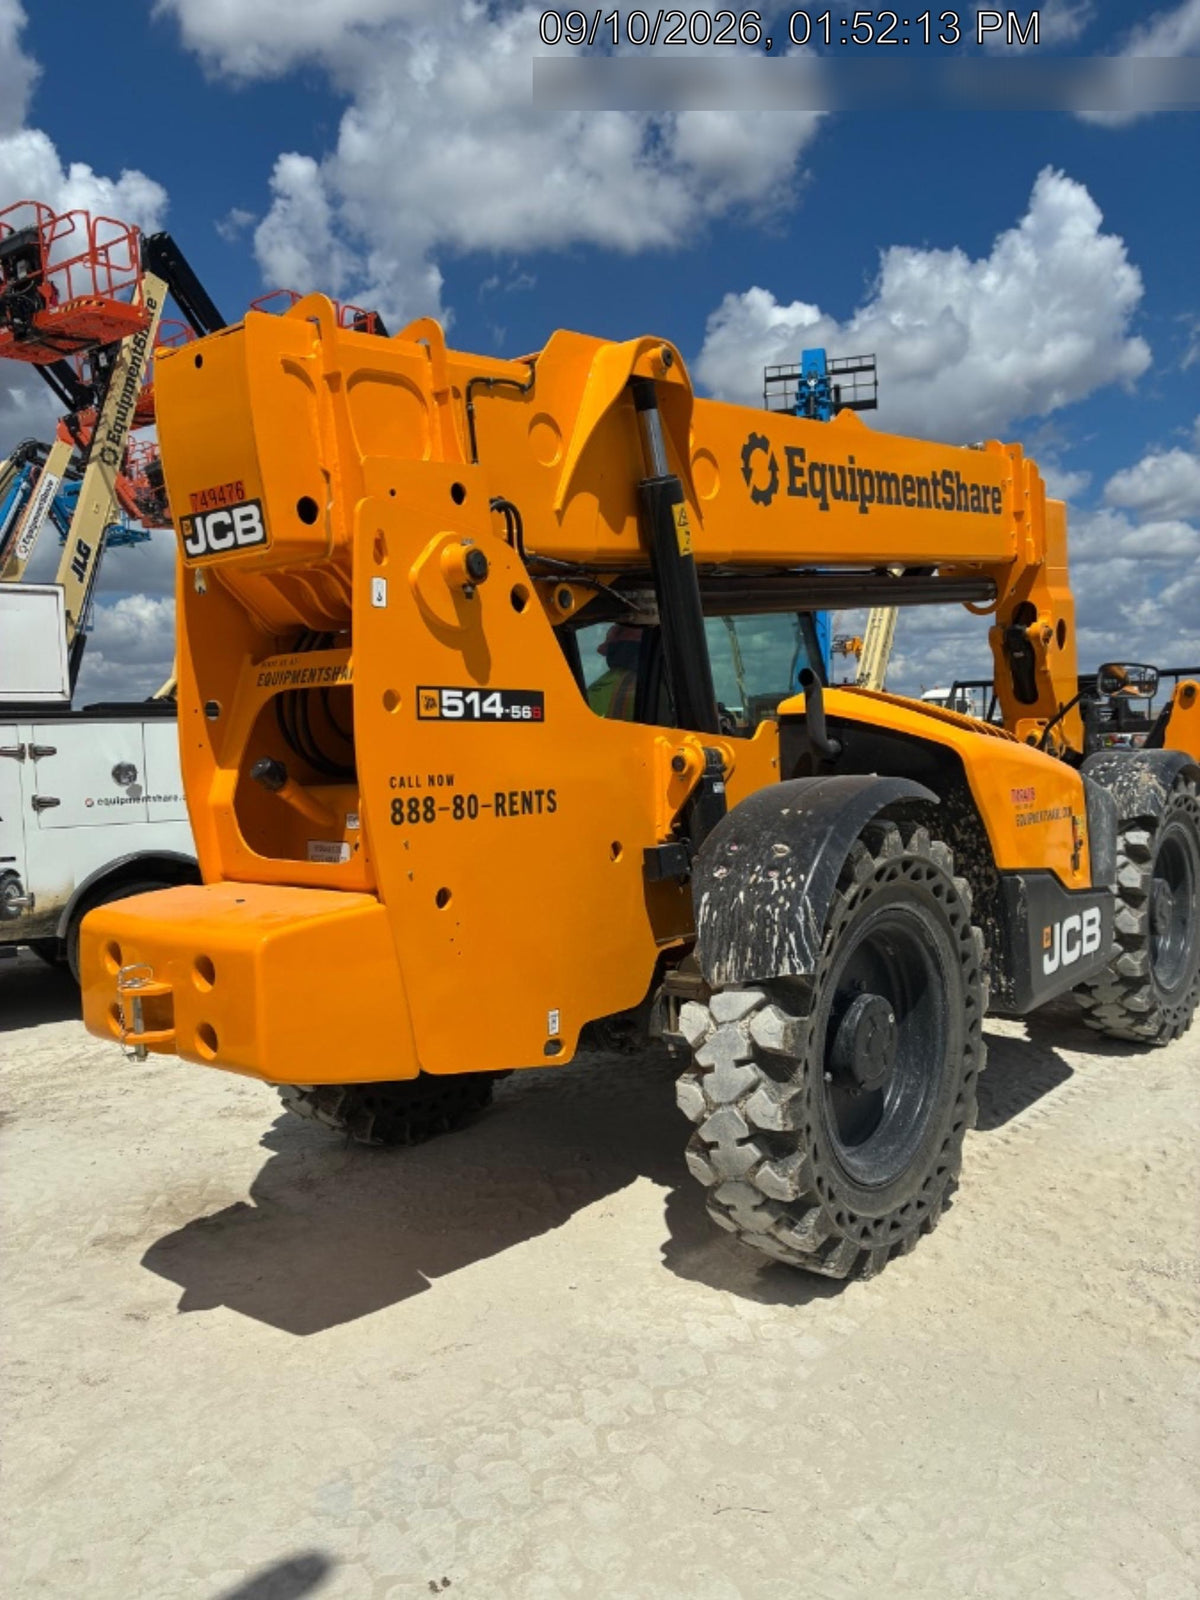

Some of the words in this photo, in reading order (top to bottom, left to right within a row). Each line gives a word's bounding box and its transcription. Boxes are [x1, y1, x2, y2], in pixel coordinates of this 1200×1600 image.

[189, 481, 245, 511] 749476
[784, 446, 1003, 515] EquipmentShare
[186, 504, 264, 555] JCB
[71, 538, 91, 584] JLG
[256, 665, 354, 687] EQUIPMENTSHA
[389, 776, 422, 789] CALL
[428, 774, 455, 787] NOW
[390, 789, 558, 826] 888-80-RENTS
[1043, 906, 1102, 976] JCB
